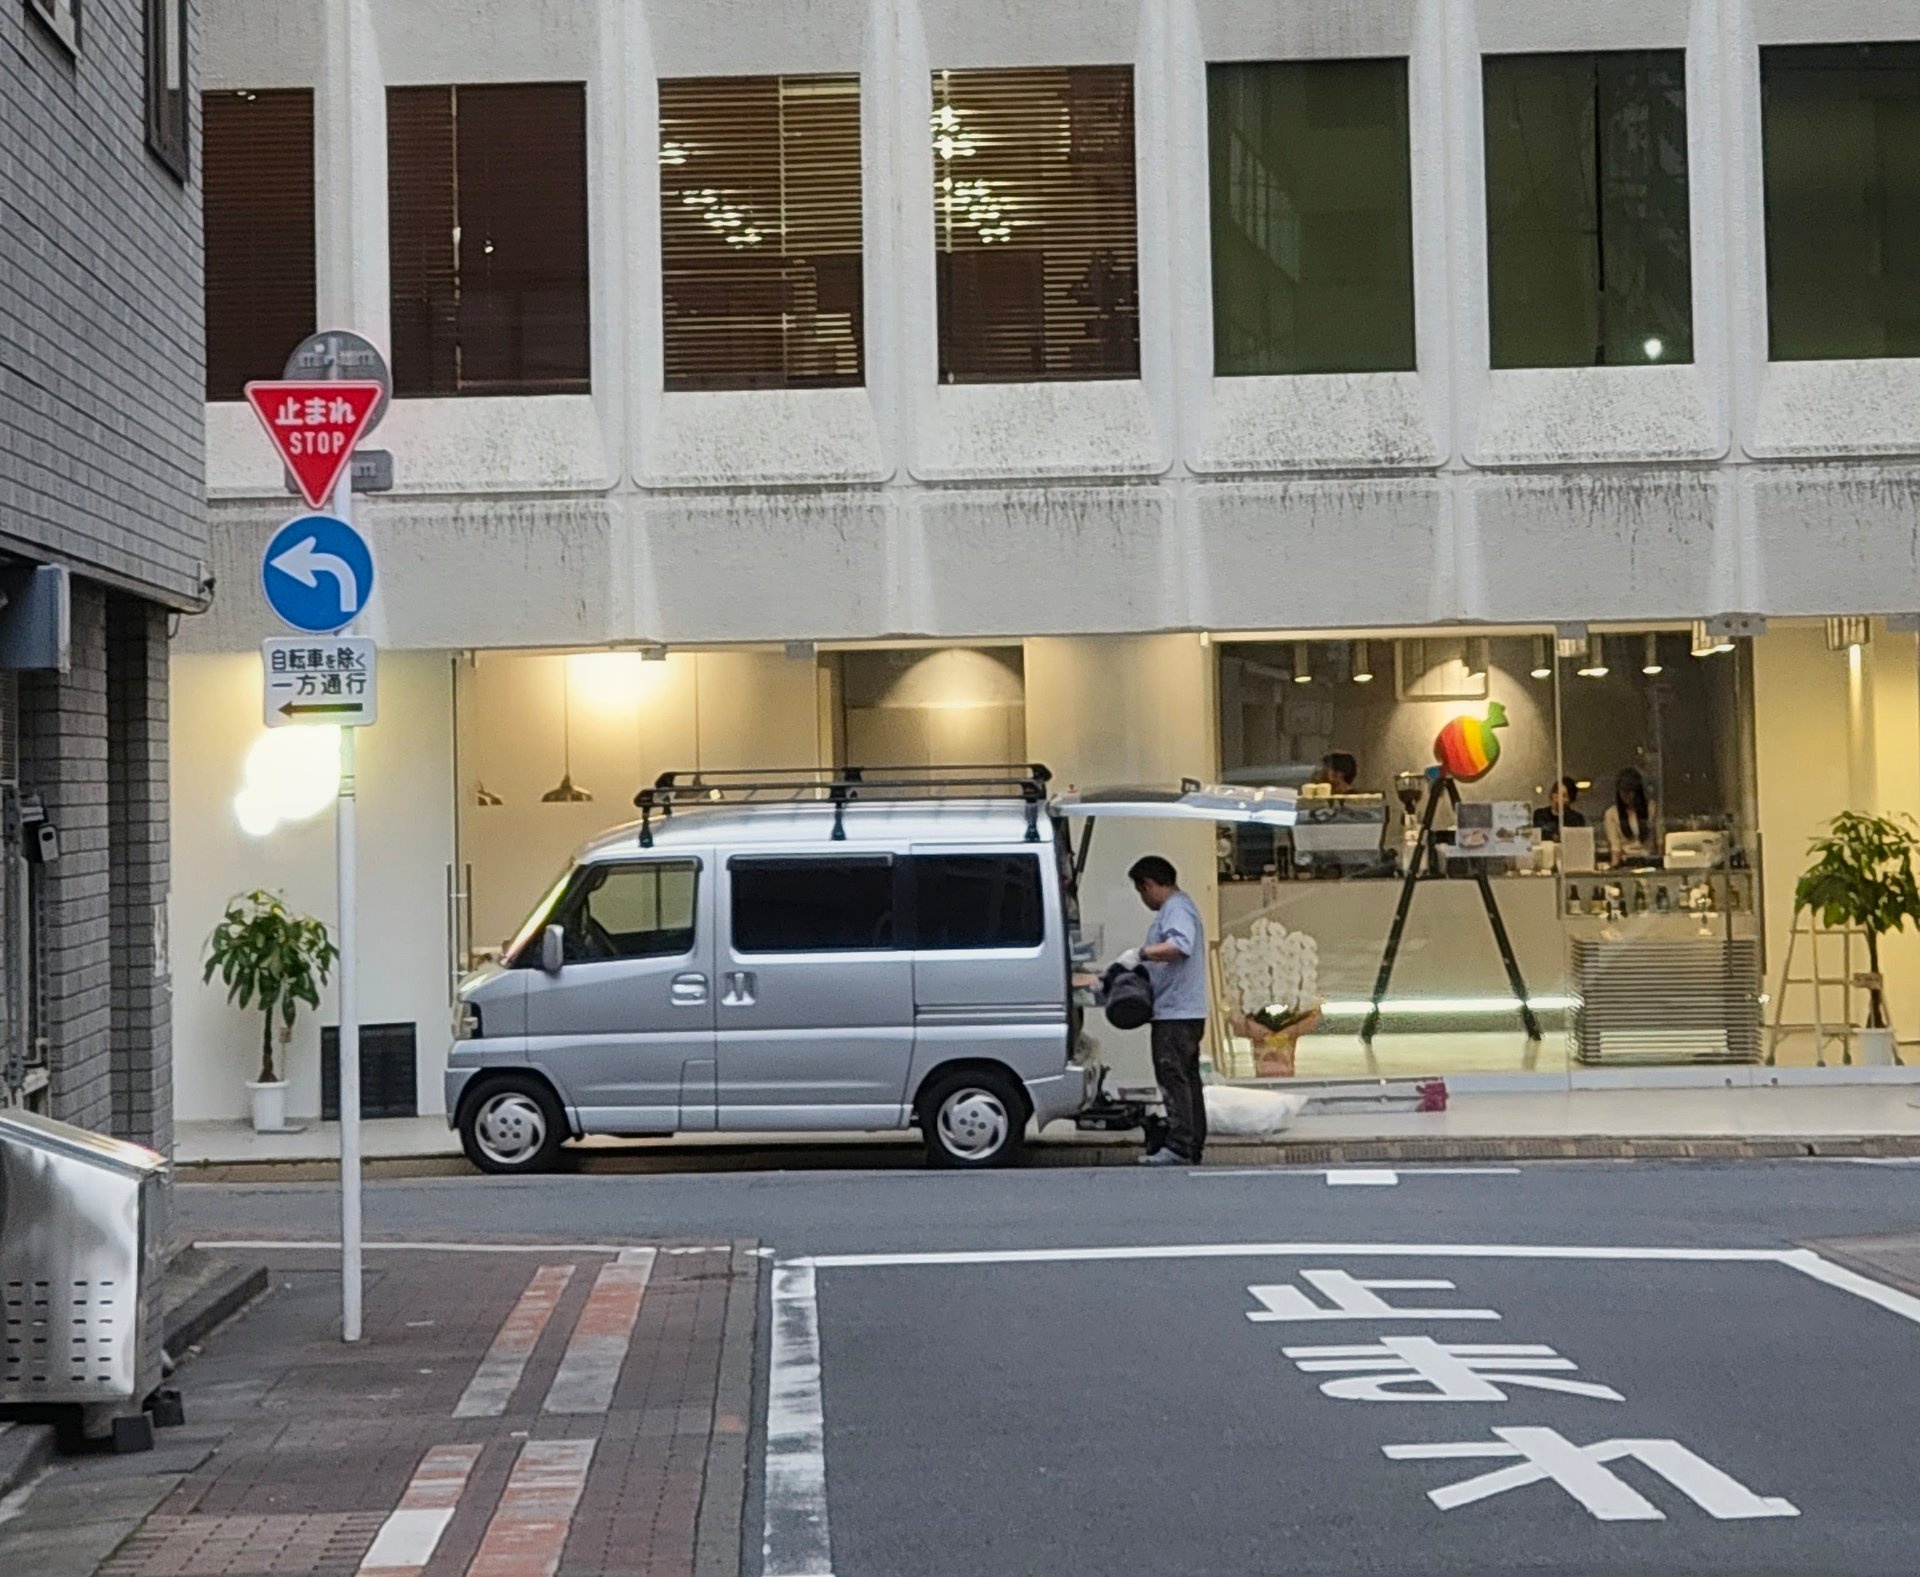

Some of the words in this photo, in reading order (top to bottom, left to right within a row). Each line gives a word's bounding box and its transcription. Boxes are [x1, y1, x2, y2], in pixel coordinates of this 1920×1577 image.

[275, 396, 356, 425] 止まれ
[289, 431, 345, 454] STOP
[271, 647, 366, 671] 自転車を除く
[271, 672, 367, 696] 一方通行
[1246, 1269, 1801, 1521] 止まれ
